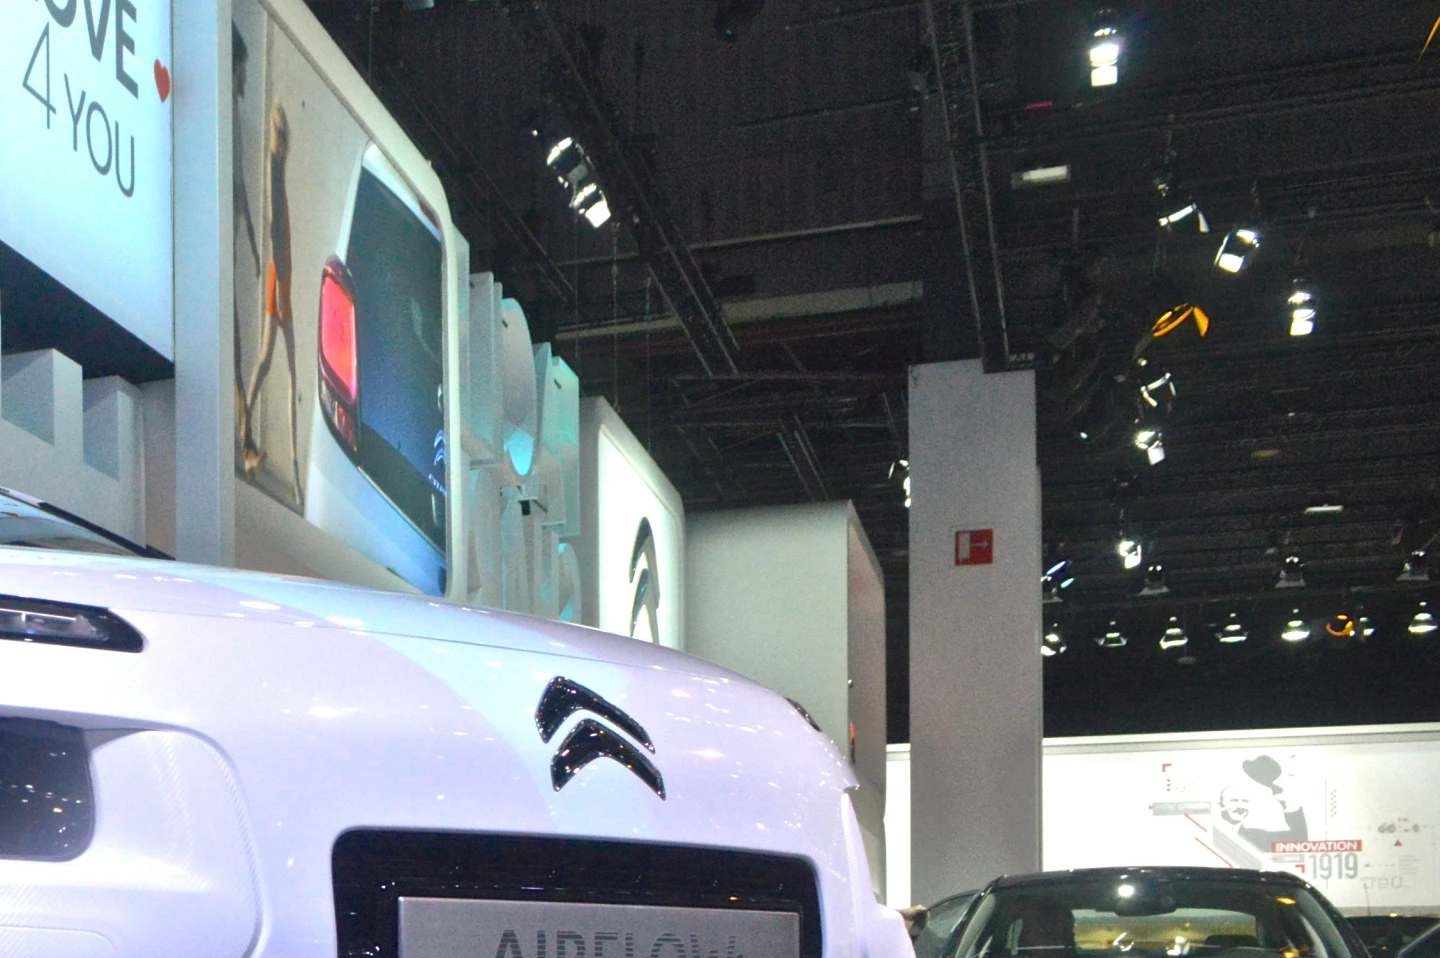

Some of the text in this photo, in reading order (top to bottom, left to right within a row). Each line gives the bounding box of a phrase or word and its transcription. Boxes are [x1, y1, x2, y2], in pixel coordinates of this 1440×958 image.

[22, 21, 135, 198] 4 YOU
[1275, 841, 1358, 852] INNOVATION
[1309, 852, 1358, 880] 1919
